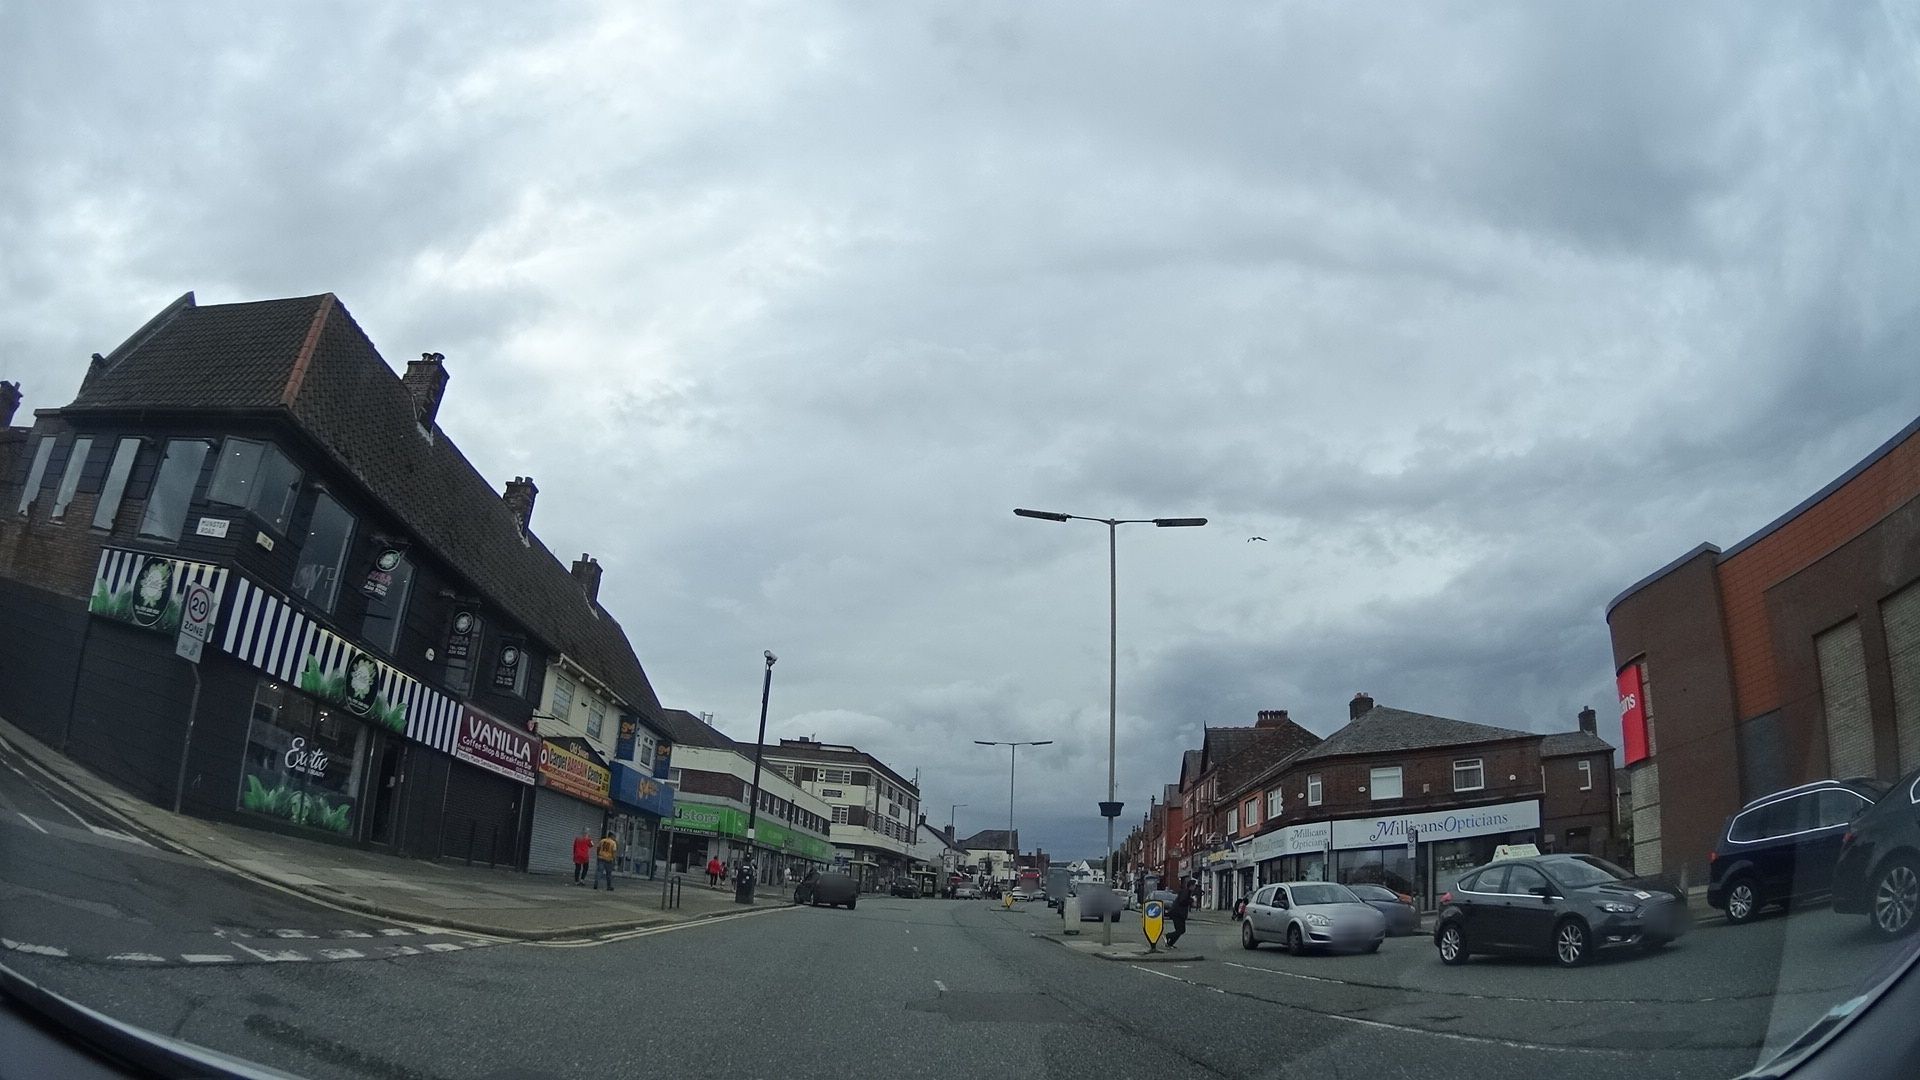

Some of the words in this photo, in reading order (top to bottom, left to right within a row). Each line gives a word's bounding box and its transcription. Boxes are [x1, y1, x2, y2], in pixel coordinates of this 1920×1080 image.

[191, 597, 207, 615] 20
[184, 621, 204, 637] ZONE
[469, 715, 531, 762] VANILLA
[462, 735, 482, 751] Coffee
[482, 744, 495, 757] Shop
[500, 752, 524, 768] Breakfast
[524, 762, 532, 770] Bar
[569, 742, 579, 755] Old
[578, 746, 589, 759] Swan
[549, 748, 567, 770] Carpet
[587, 765, 602, 785] Centre
[1290, 829, 1327, 841] Millicans
[1292, 838, 1329, 850] Opticians
